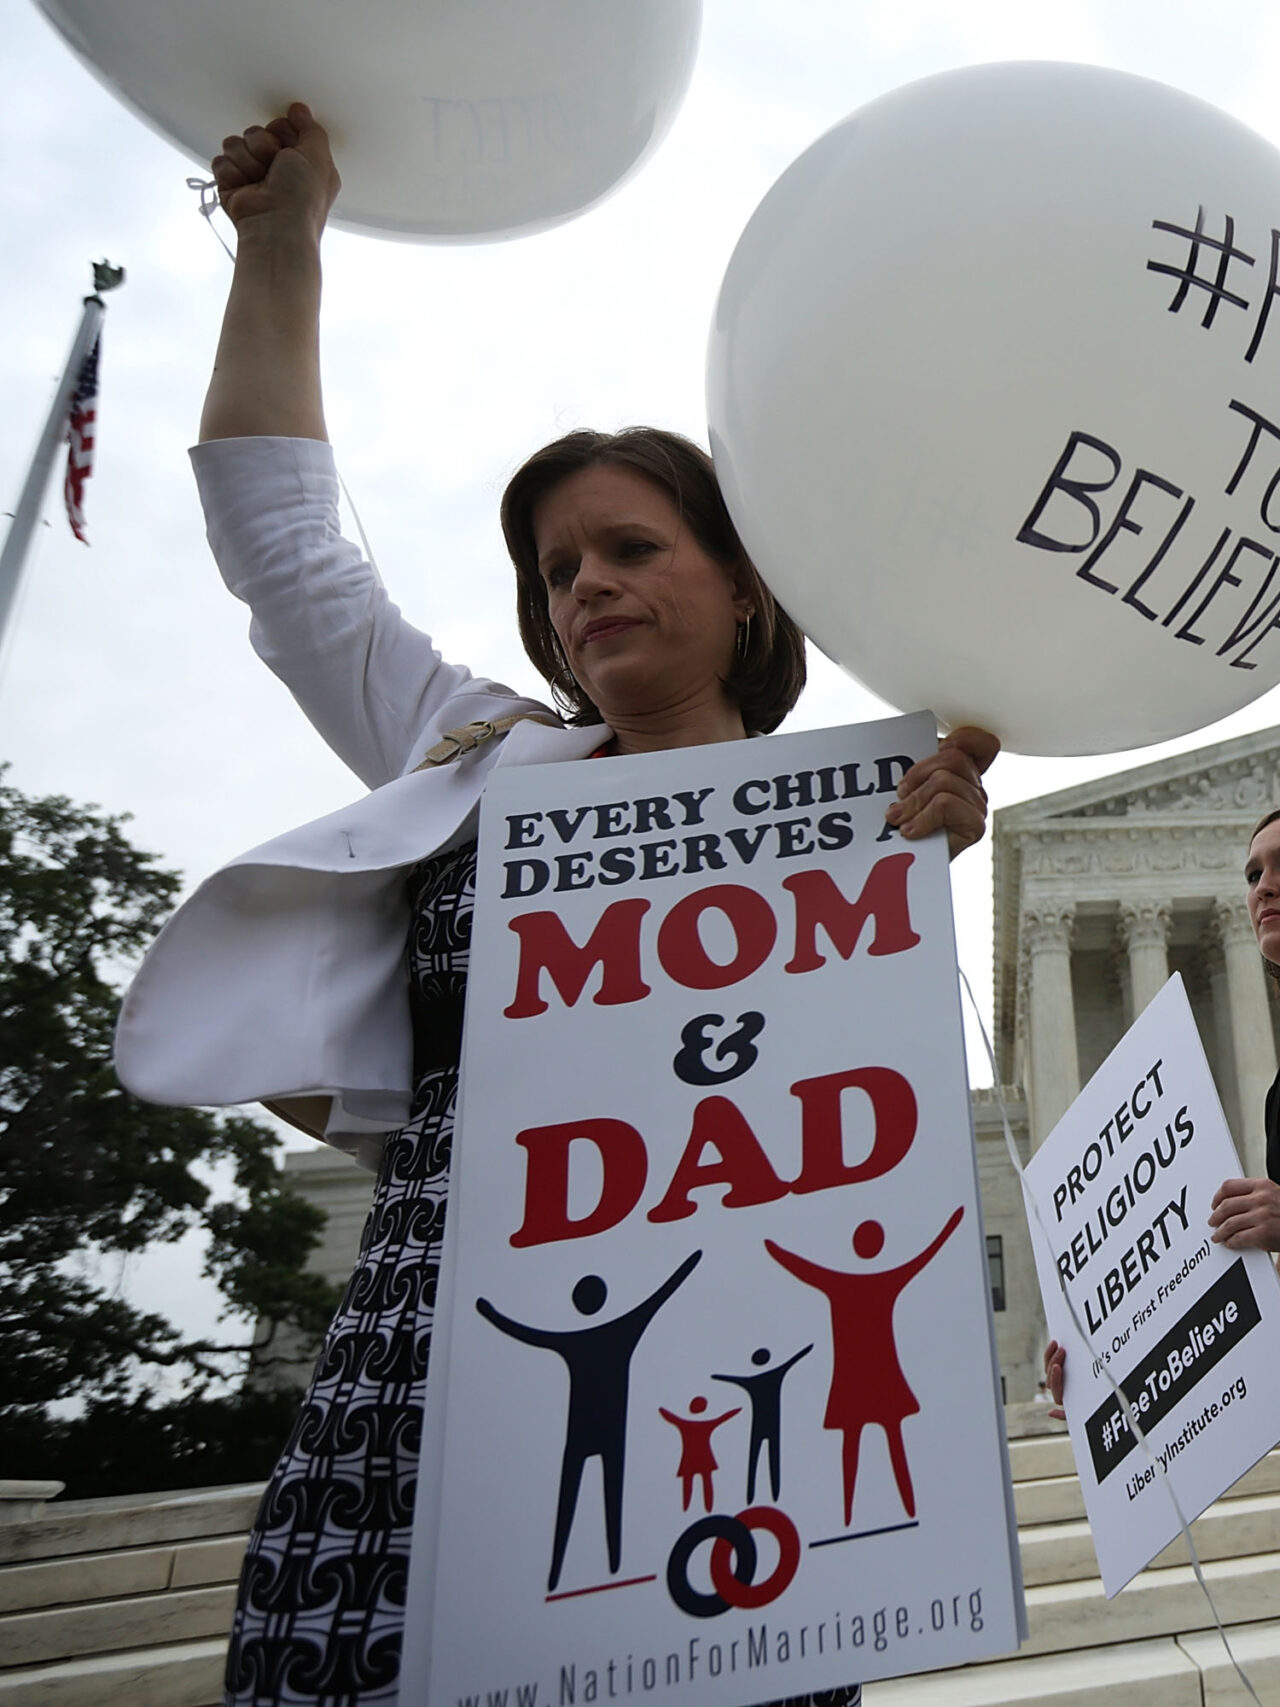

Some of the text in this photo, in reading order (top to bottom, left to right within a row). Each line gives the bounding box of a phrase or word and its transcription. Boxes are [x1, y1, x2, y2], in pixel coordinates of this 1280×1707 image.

[500, 811, 855, 899] DESERVES
[504, 755, 916, 851] EVERY CHILD
[503, 852, 922, 1020] MOM
[673, 1011, 766, 1087] &
[509, 1066, 919, 1249] DAD
[1052, 1058, 1164, 1223] PROTECT
[1056, 1105, 1195, 1292] RELIGIOUS
[1083, 1184, 1190, 1337] LIBERTY
[1112, 1327, 1130, 1353] Our
[1132, 1299, 1157, 1332] First
[1156, 1239, 1211, 1304] Freedom)
[1102, 1300, 1239, 1452] #FreeToBelieve
[1126, 1376, 1248, 1501] LiberyInstitute.org
